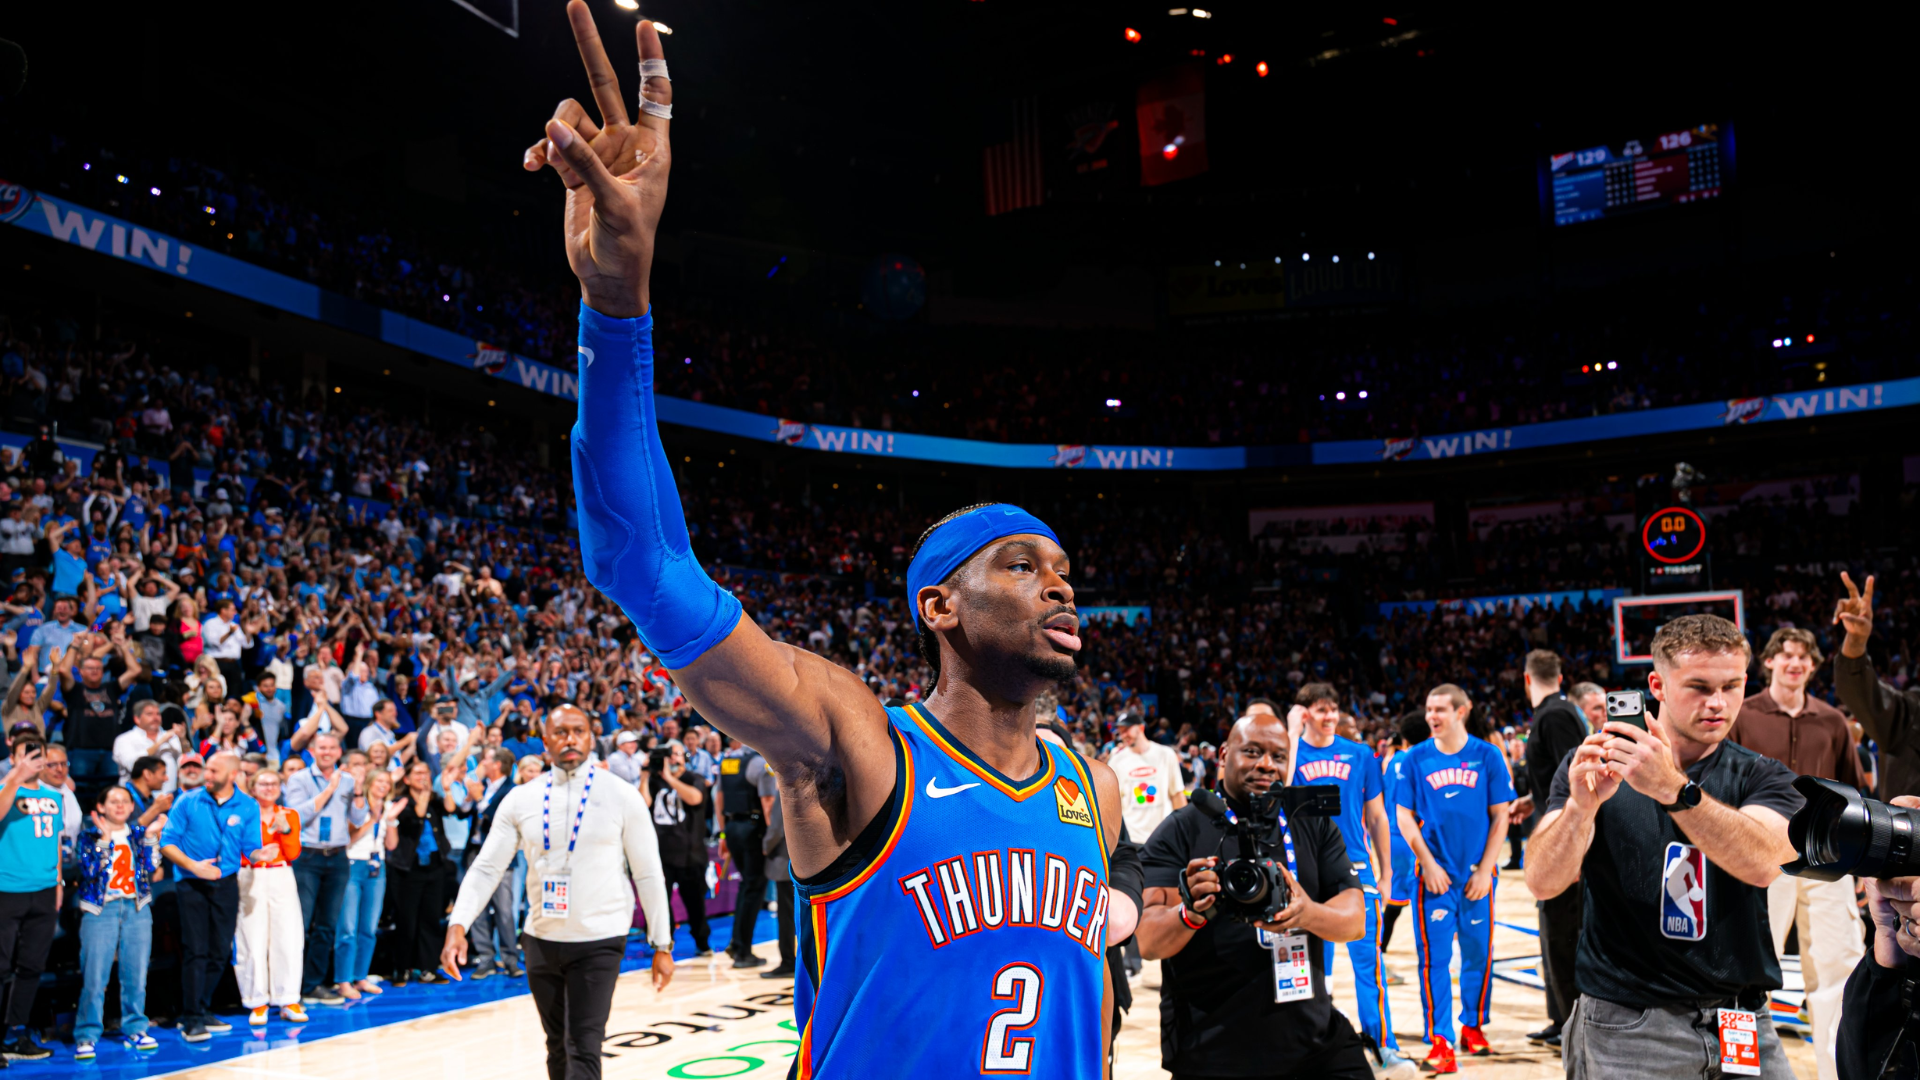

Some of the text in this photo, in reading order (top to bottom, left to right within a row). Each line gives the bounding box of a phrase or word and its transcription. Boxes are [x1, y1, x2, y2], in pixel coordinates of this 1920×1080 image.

[1660, 131, 1692, 151] 126
[1576, 149, 1606, 166] 129
[38, 198, 192, 275] WIN!
[1772, 385, 1883, 419] WIN!
[811, 427, 894, 453] WIN!
[1422, 430, 1512, 459] WIN!
[1091, 448, 1174, 470] WIN!
[1661, 516, 1685, 533] 0.0
[1664, 564, 1702, 575] TISSOT
[1299, 760, 1351, 781] THUNDER
[1426, 768, 1478, 790] THUNDER
[32, 815, 54, 838] 13
[898, 848, 1110, 960] THUNDER
[1667, 916, 1688, 933] NBA
[980, 961, 1045, 1075] 2
[1720, 1011, 1754, 1023] 2025
[1726, 1043, 1737, 1056] M
